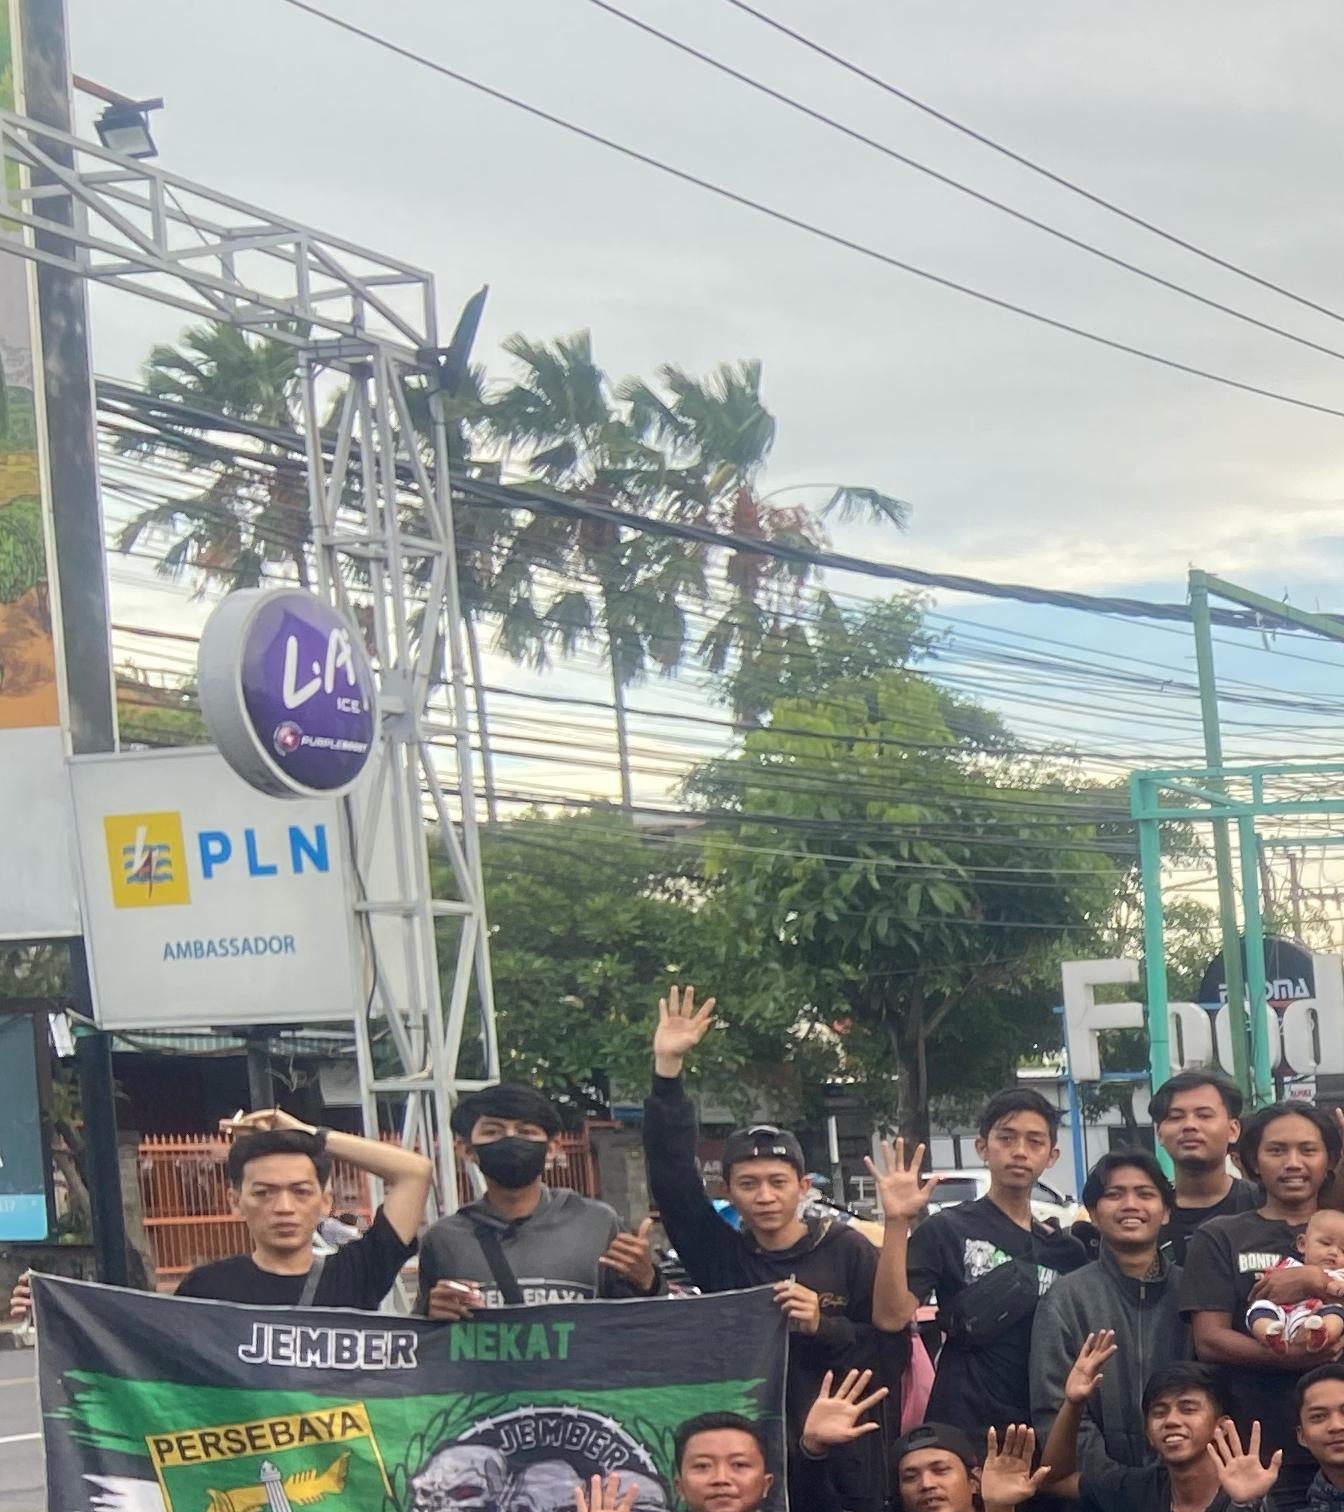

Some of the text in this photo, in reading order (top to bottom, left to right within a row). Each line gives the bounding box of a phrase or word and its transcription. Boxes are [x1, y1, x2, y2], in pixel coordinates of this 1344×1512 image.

[198, 823, 330, 879] PLN
[162, 934, 296, 961] AMBASSADOR
[1219, 977, 1310, 1002] POMA
[238, 1319, 576, 1371] JEMBER NEKAT
[152, 1409, 366, 1466] PERSEBAYA
[497, 1415, 629, 1473] JEMBER
